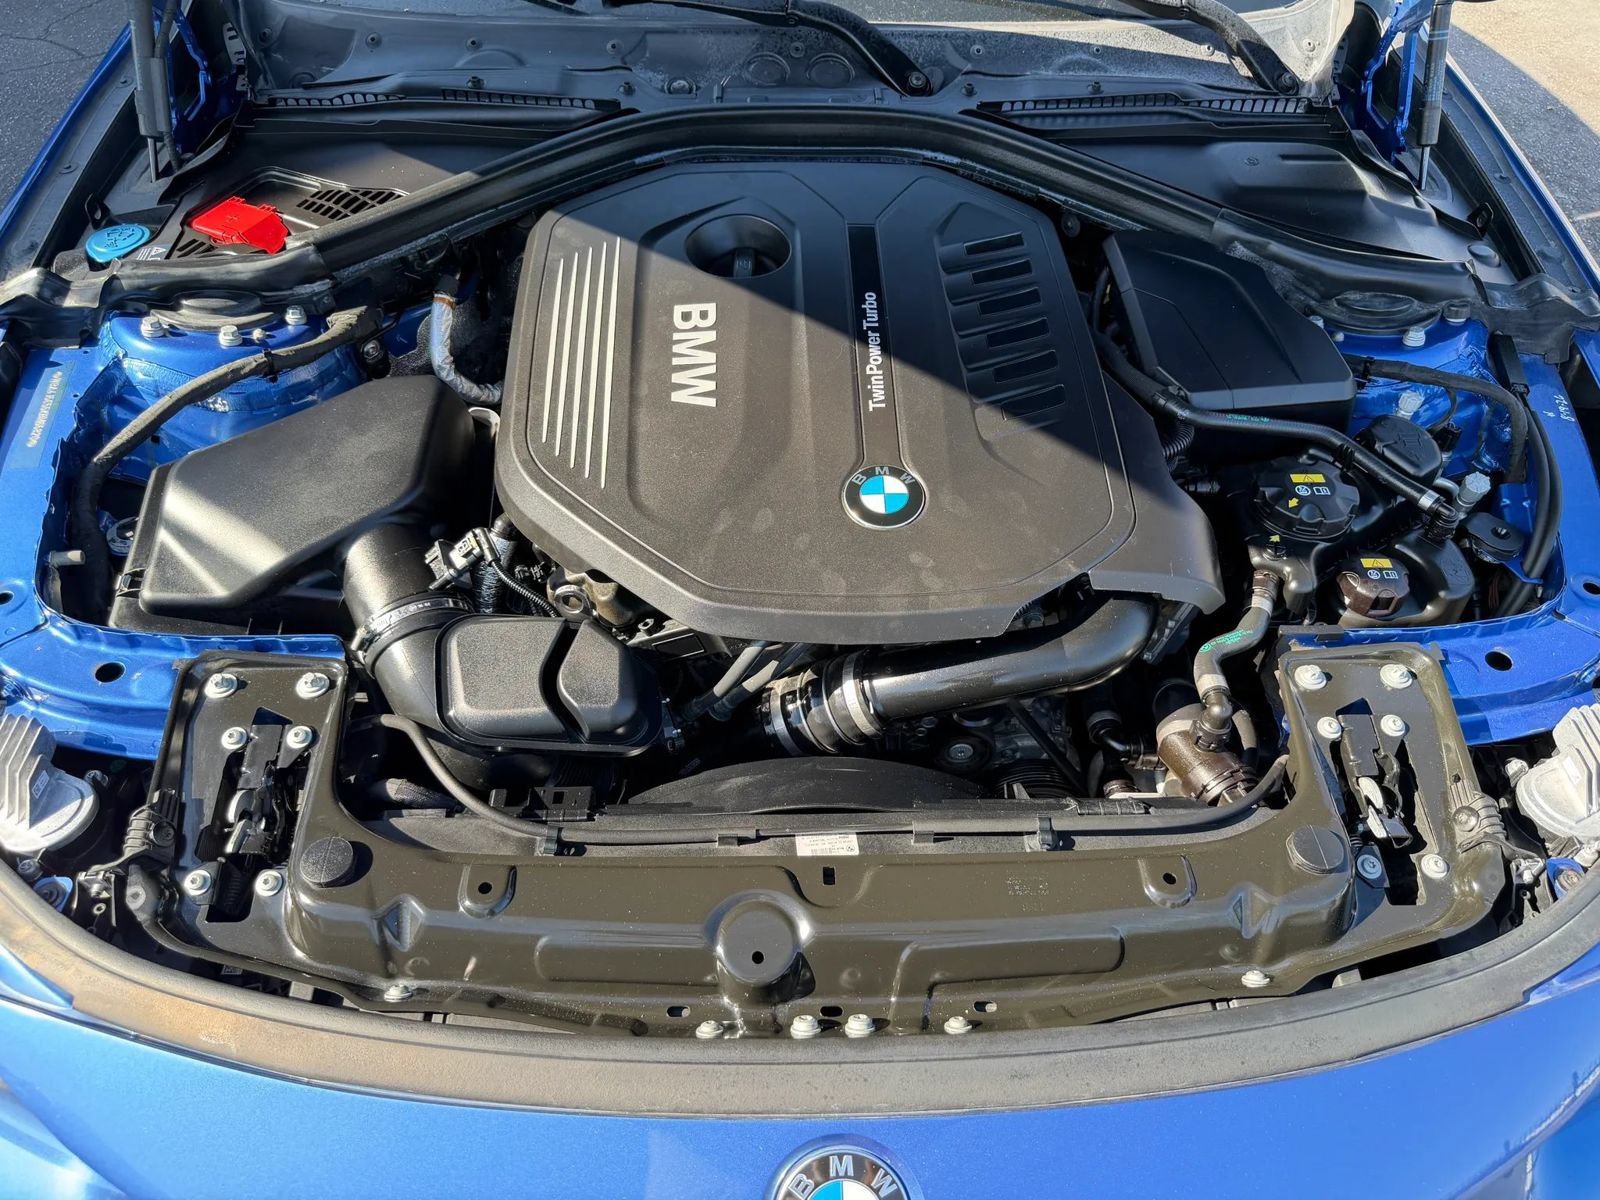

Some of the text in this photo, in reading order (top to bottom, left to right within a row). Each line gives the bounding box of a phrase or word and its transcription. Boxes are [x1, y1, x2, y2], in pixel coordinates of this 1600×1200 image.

[671, 302, 717, 408] BMW
[861, 291, 886, 412] TwinPower Turbo
[851, 466, 916, 486] BMW
[787, 1154, 898, 1200] BMW
